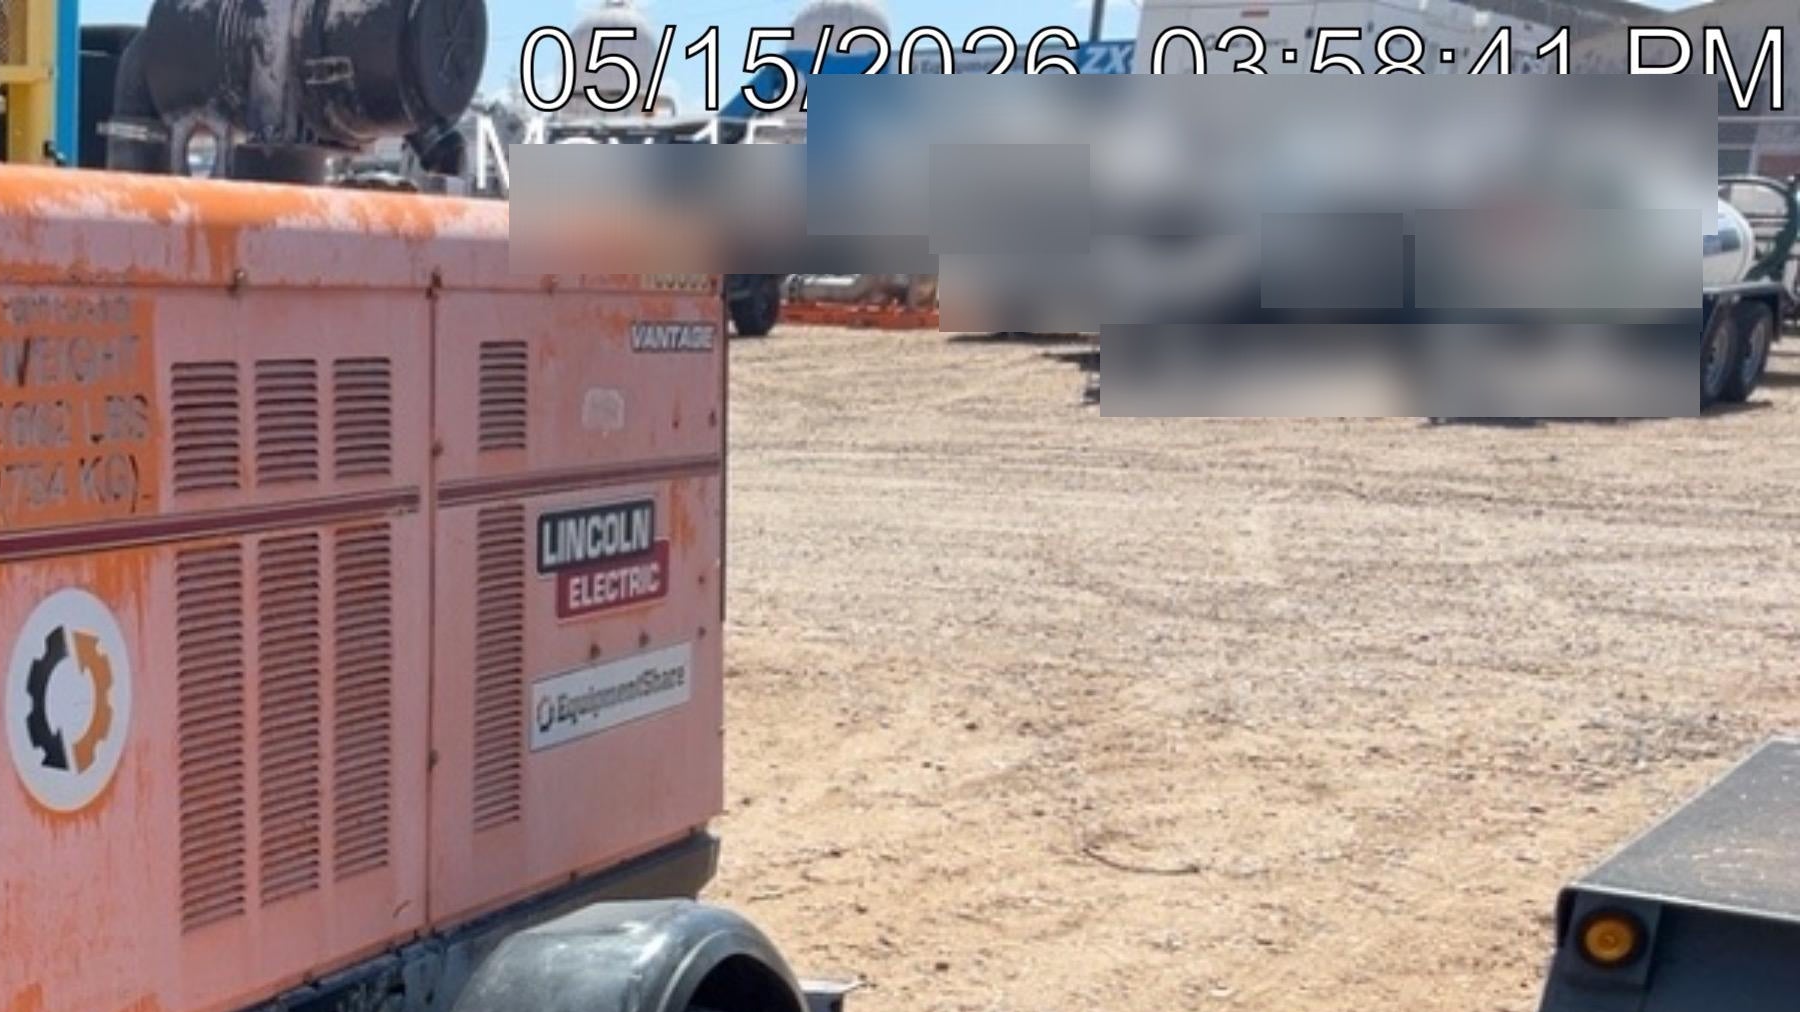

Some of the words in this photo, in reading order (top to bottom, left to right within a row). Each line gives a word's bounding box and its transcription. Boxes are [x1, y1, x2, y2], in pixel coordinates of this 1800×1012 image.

[631, 325, 715, 351] VANTAGE
[542, 508, 651, 567] LINCOLN
[568, 561, 661, 610] ELECTRIC
[557, 665, 686, 726] EquipmentShare
